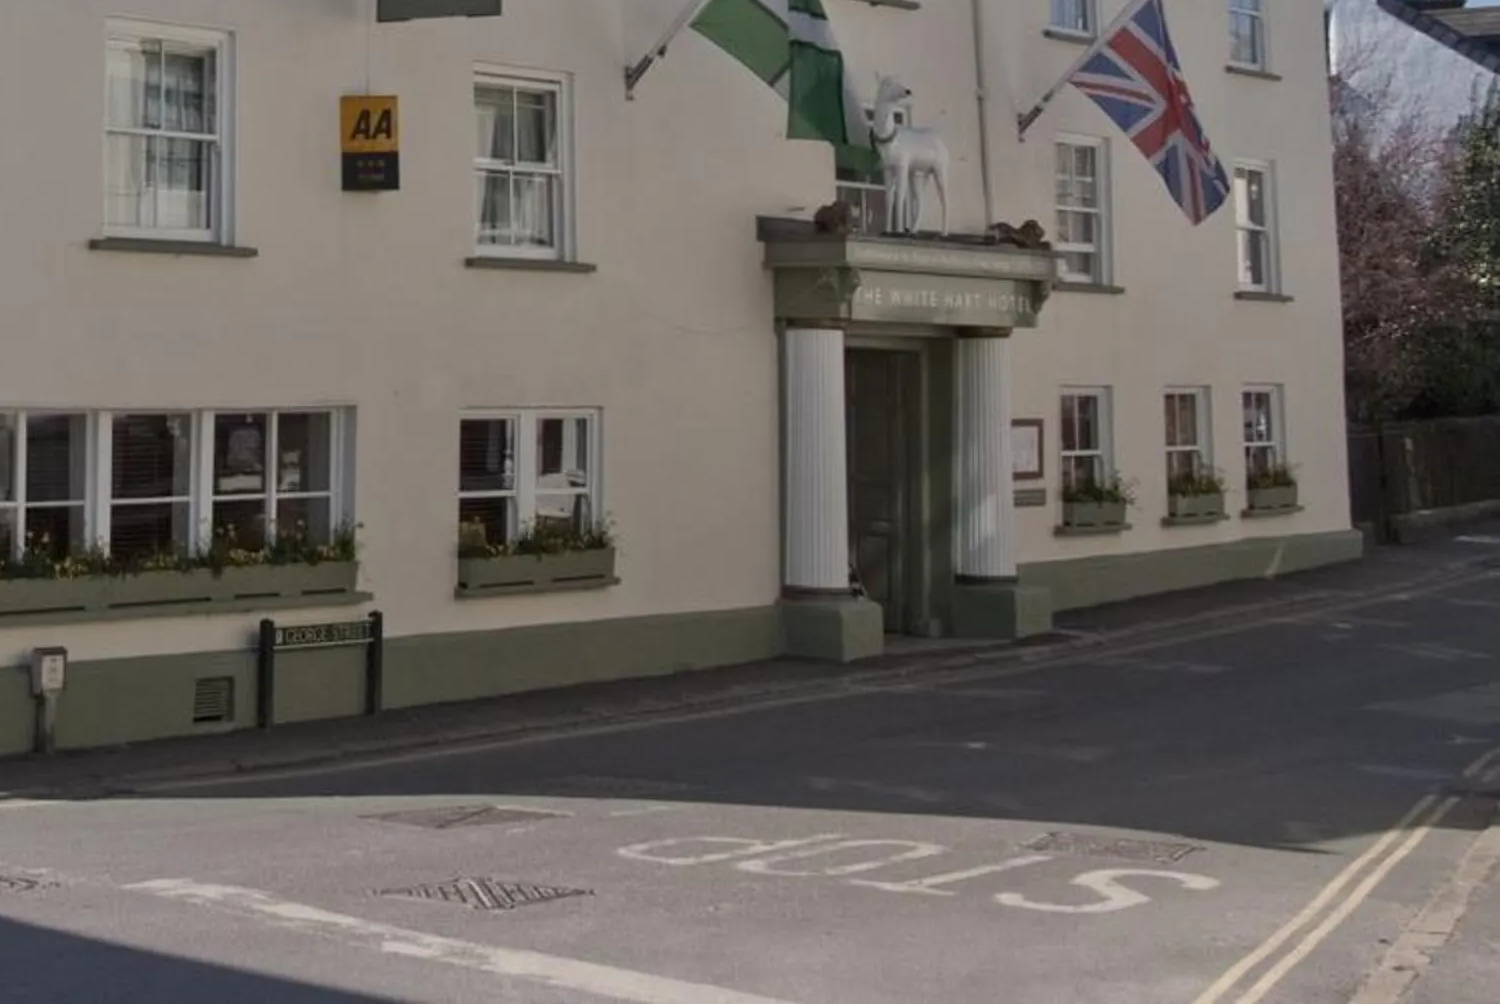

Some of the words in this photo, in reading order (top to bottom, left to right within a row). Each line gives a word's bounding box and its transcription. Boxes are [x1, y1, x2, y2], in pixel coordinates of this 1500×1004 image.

[351, 108, 392, 139] AA
[855, 286, 882, 305] THE
[890, 288, 940, 308] WHITE
[944, 291, 980, 310] HART
[987, 293, 1032, 313] HOTEL
[286, 627, 325, 643] GEORGE
[616, 833, 1222, 914] STOP
